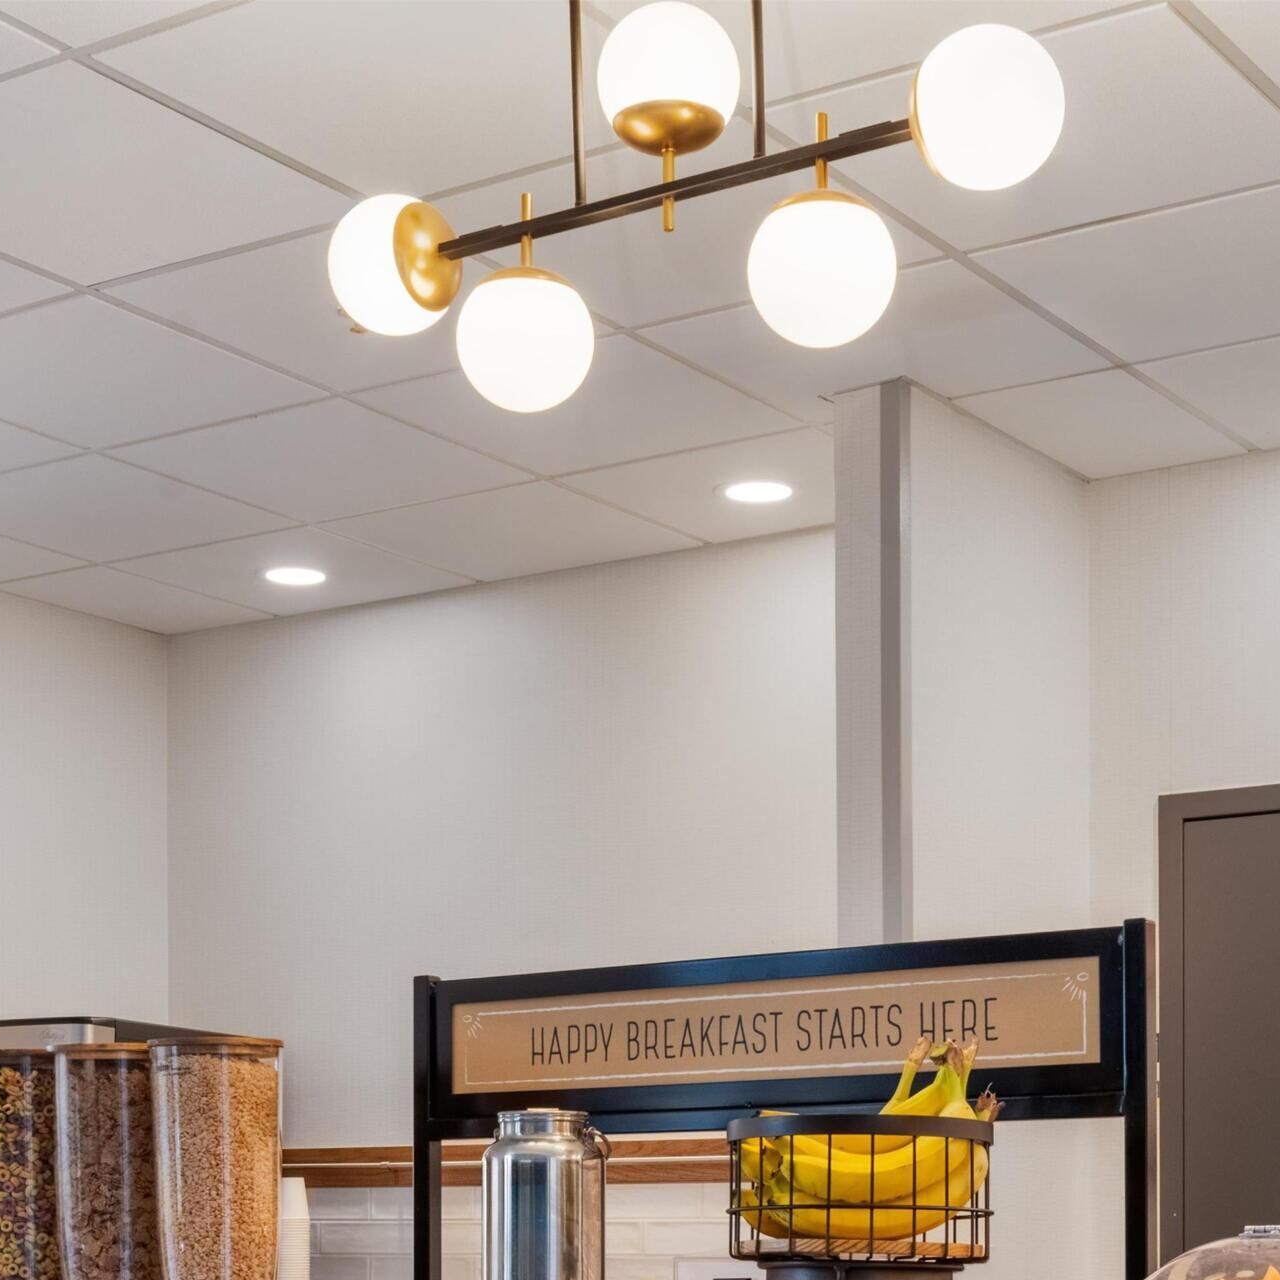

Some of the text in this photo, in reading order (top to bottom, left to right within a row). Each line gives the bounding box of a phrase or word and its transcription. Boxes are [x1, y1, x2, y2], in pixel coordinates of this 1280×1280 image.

[531, 997, 999, 1066] HAPPY BREAKFAST STARTS HERE
